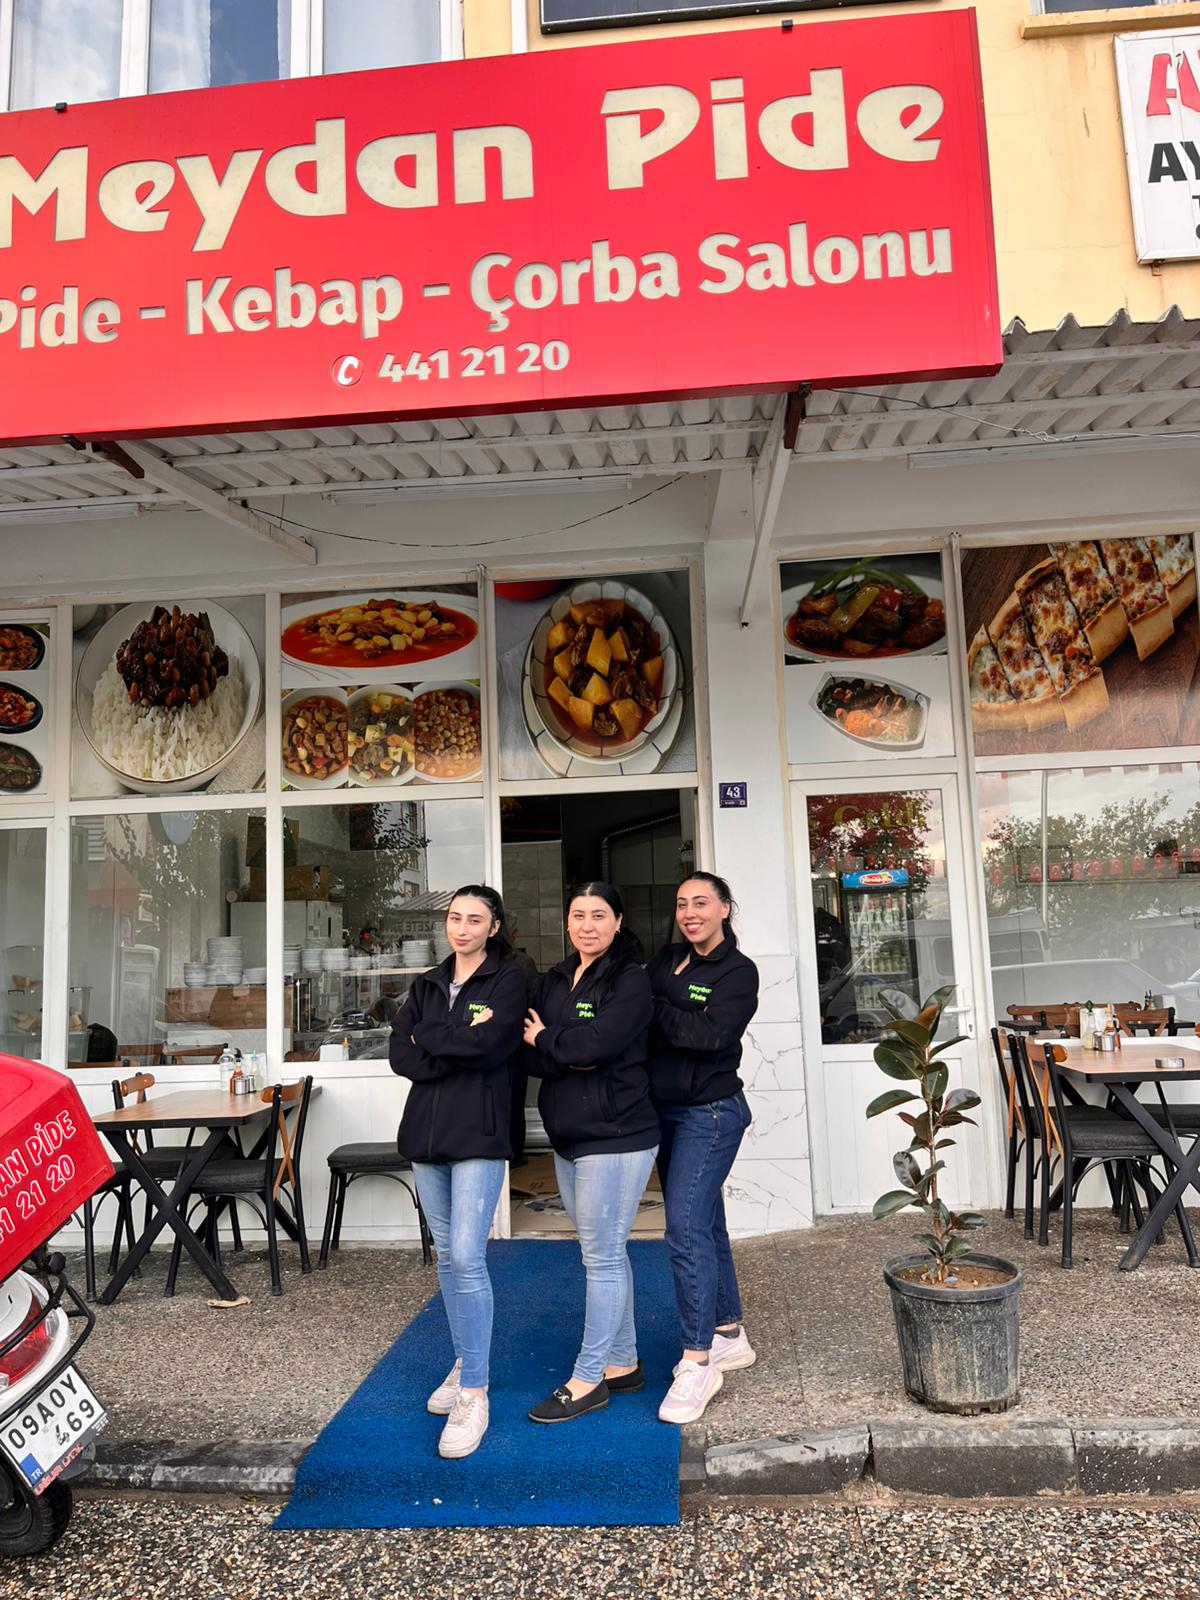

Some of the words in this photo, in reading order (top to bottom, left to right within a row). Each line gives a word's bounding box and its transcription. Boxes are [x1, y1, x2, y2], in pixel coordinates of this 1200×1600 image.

[0, 117, 535, 253] Meydan
[600, 66, 944, 190] Pide
[185, 266, 404, 340] Kebap
[470, 239, 681, 333] Çorba
[698, 221, 953, 295] Salonu
[378, 349, 449, 383] 441
[460, 344, 506, 378] 21
[515, 339, 570, 373] 20
[726, 786, 741, 799] 43
[25, 1109, 77, 1166] PİDE
[16, 1180, 47, 1220] 21
[46, 1154, 75, 1192] 20
[30, 1467, 43, 1481] TR
